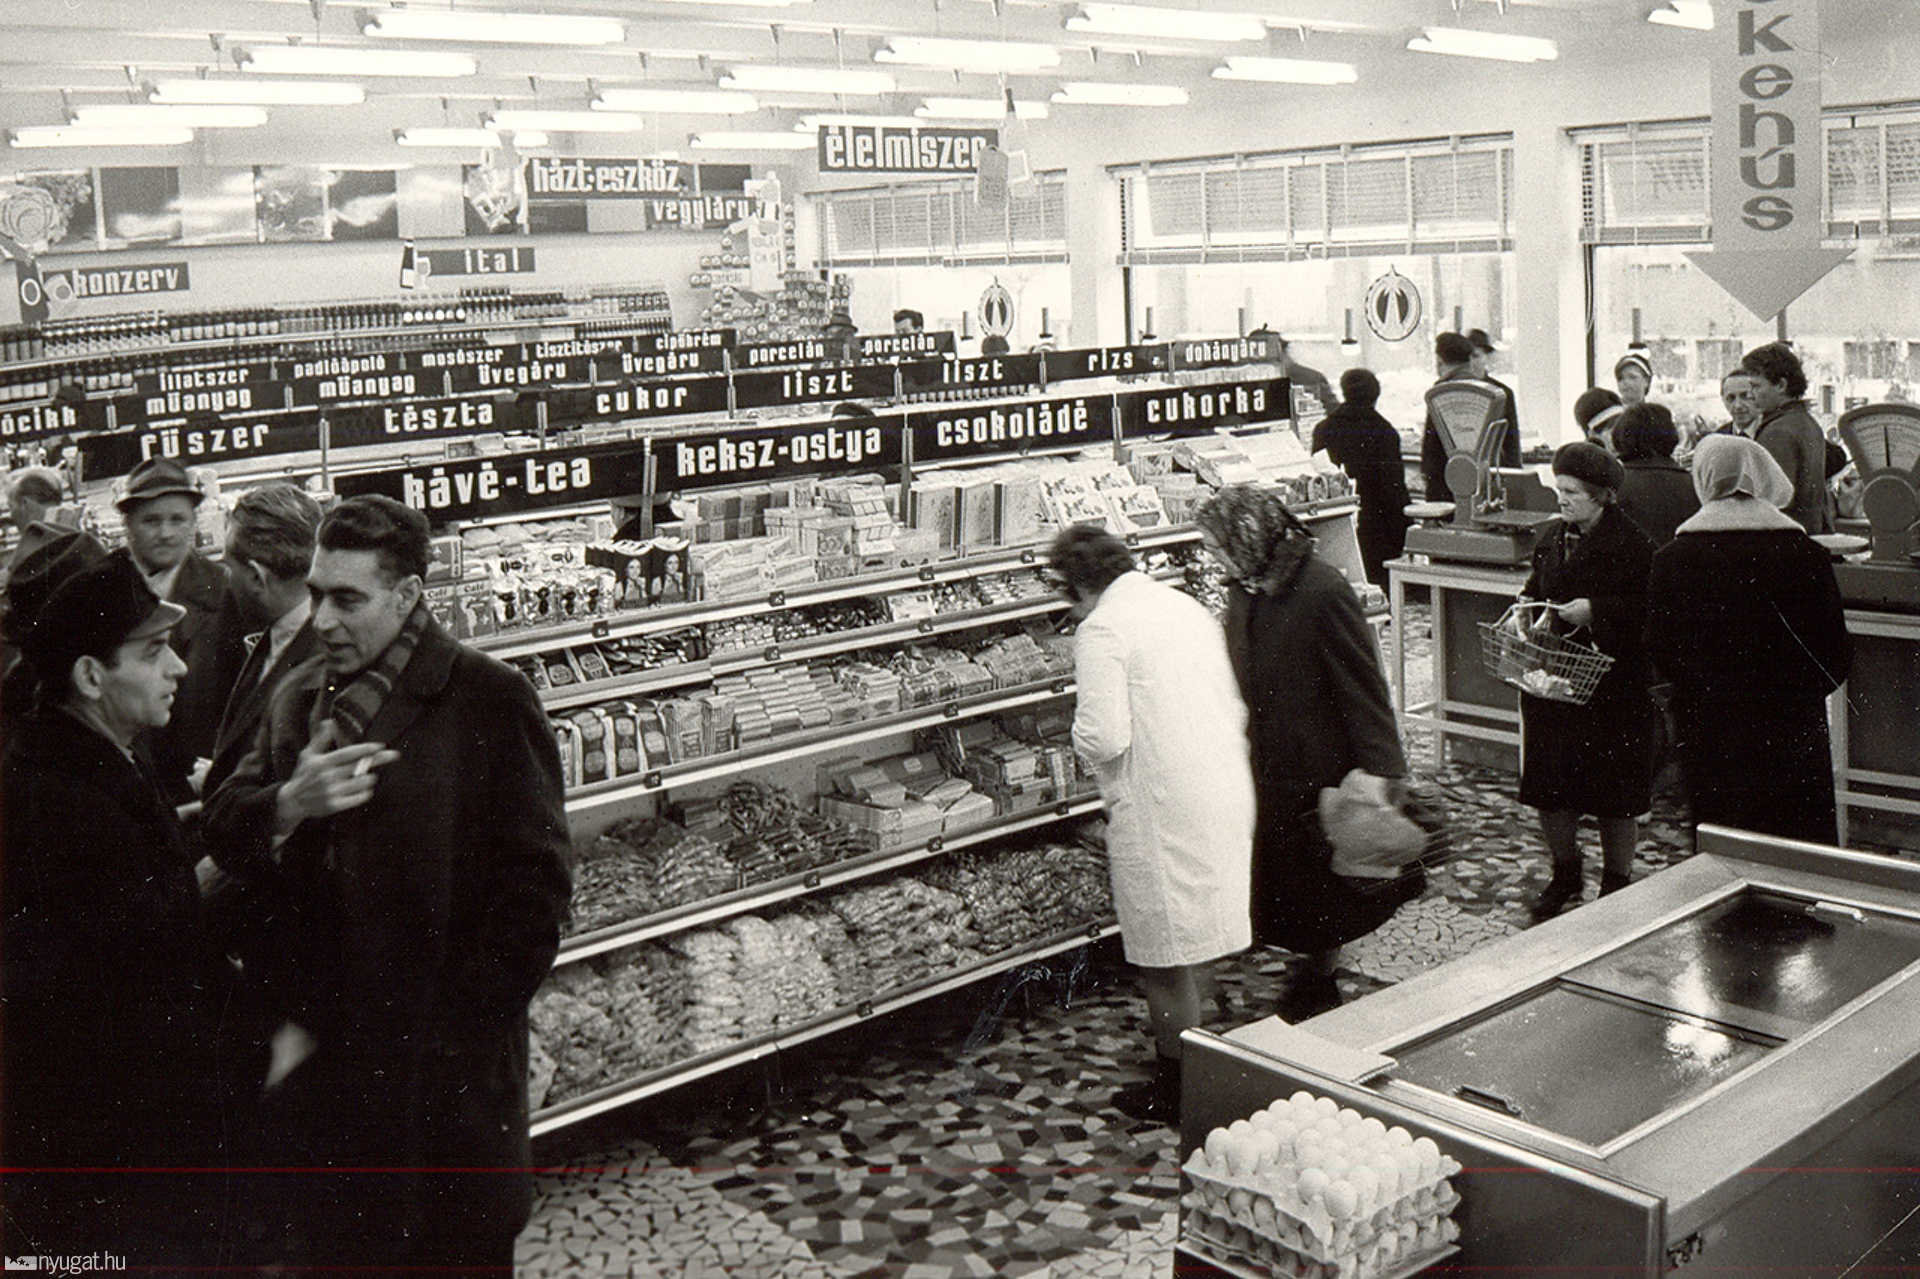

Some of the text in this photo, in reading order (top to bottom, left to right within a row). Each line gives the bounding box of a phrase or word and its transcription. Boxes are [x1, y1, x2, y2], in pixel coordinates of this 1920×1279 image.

[465, 248, 520, 274] ital
[72, 268, 178, 296] konzerv
[942, 360, 1003, 385] liszt
[1088, 348, 1134, 372] rizs
[159, 367, 250, 393] illatszer
[783, 369, 853, 398] liszt
[596, 386, 688, 414] cukor
[1147, 386, 1265, 423] cukorka
[383, 401, 494, 434] tészta
[937, 401, 1088, 446] csokoládé
